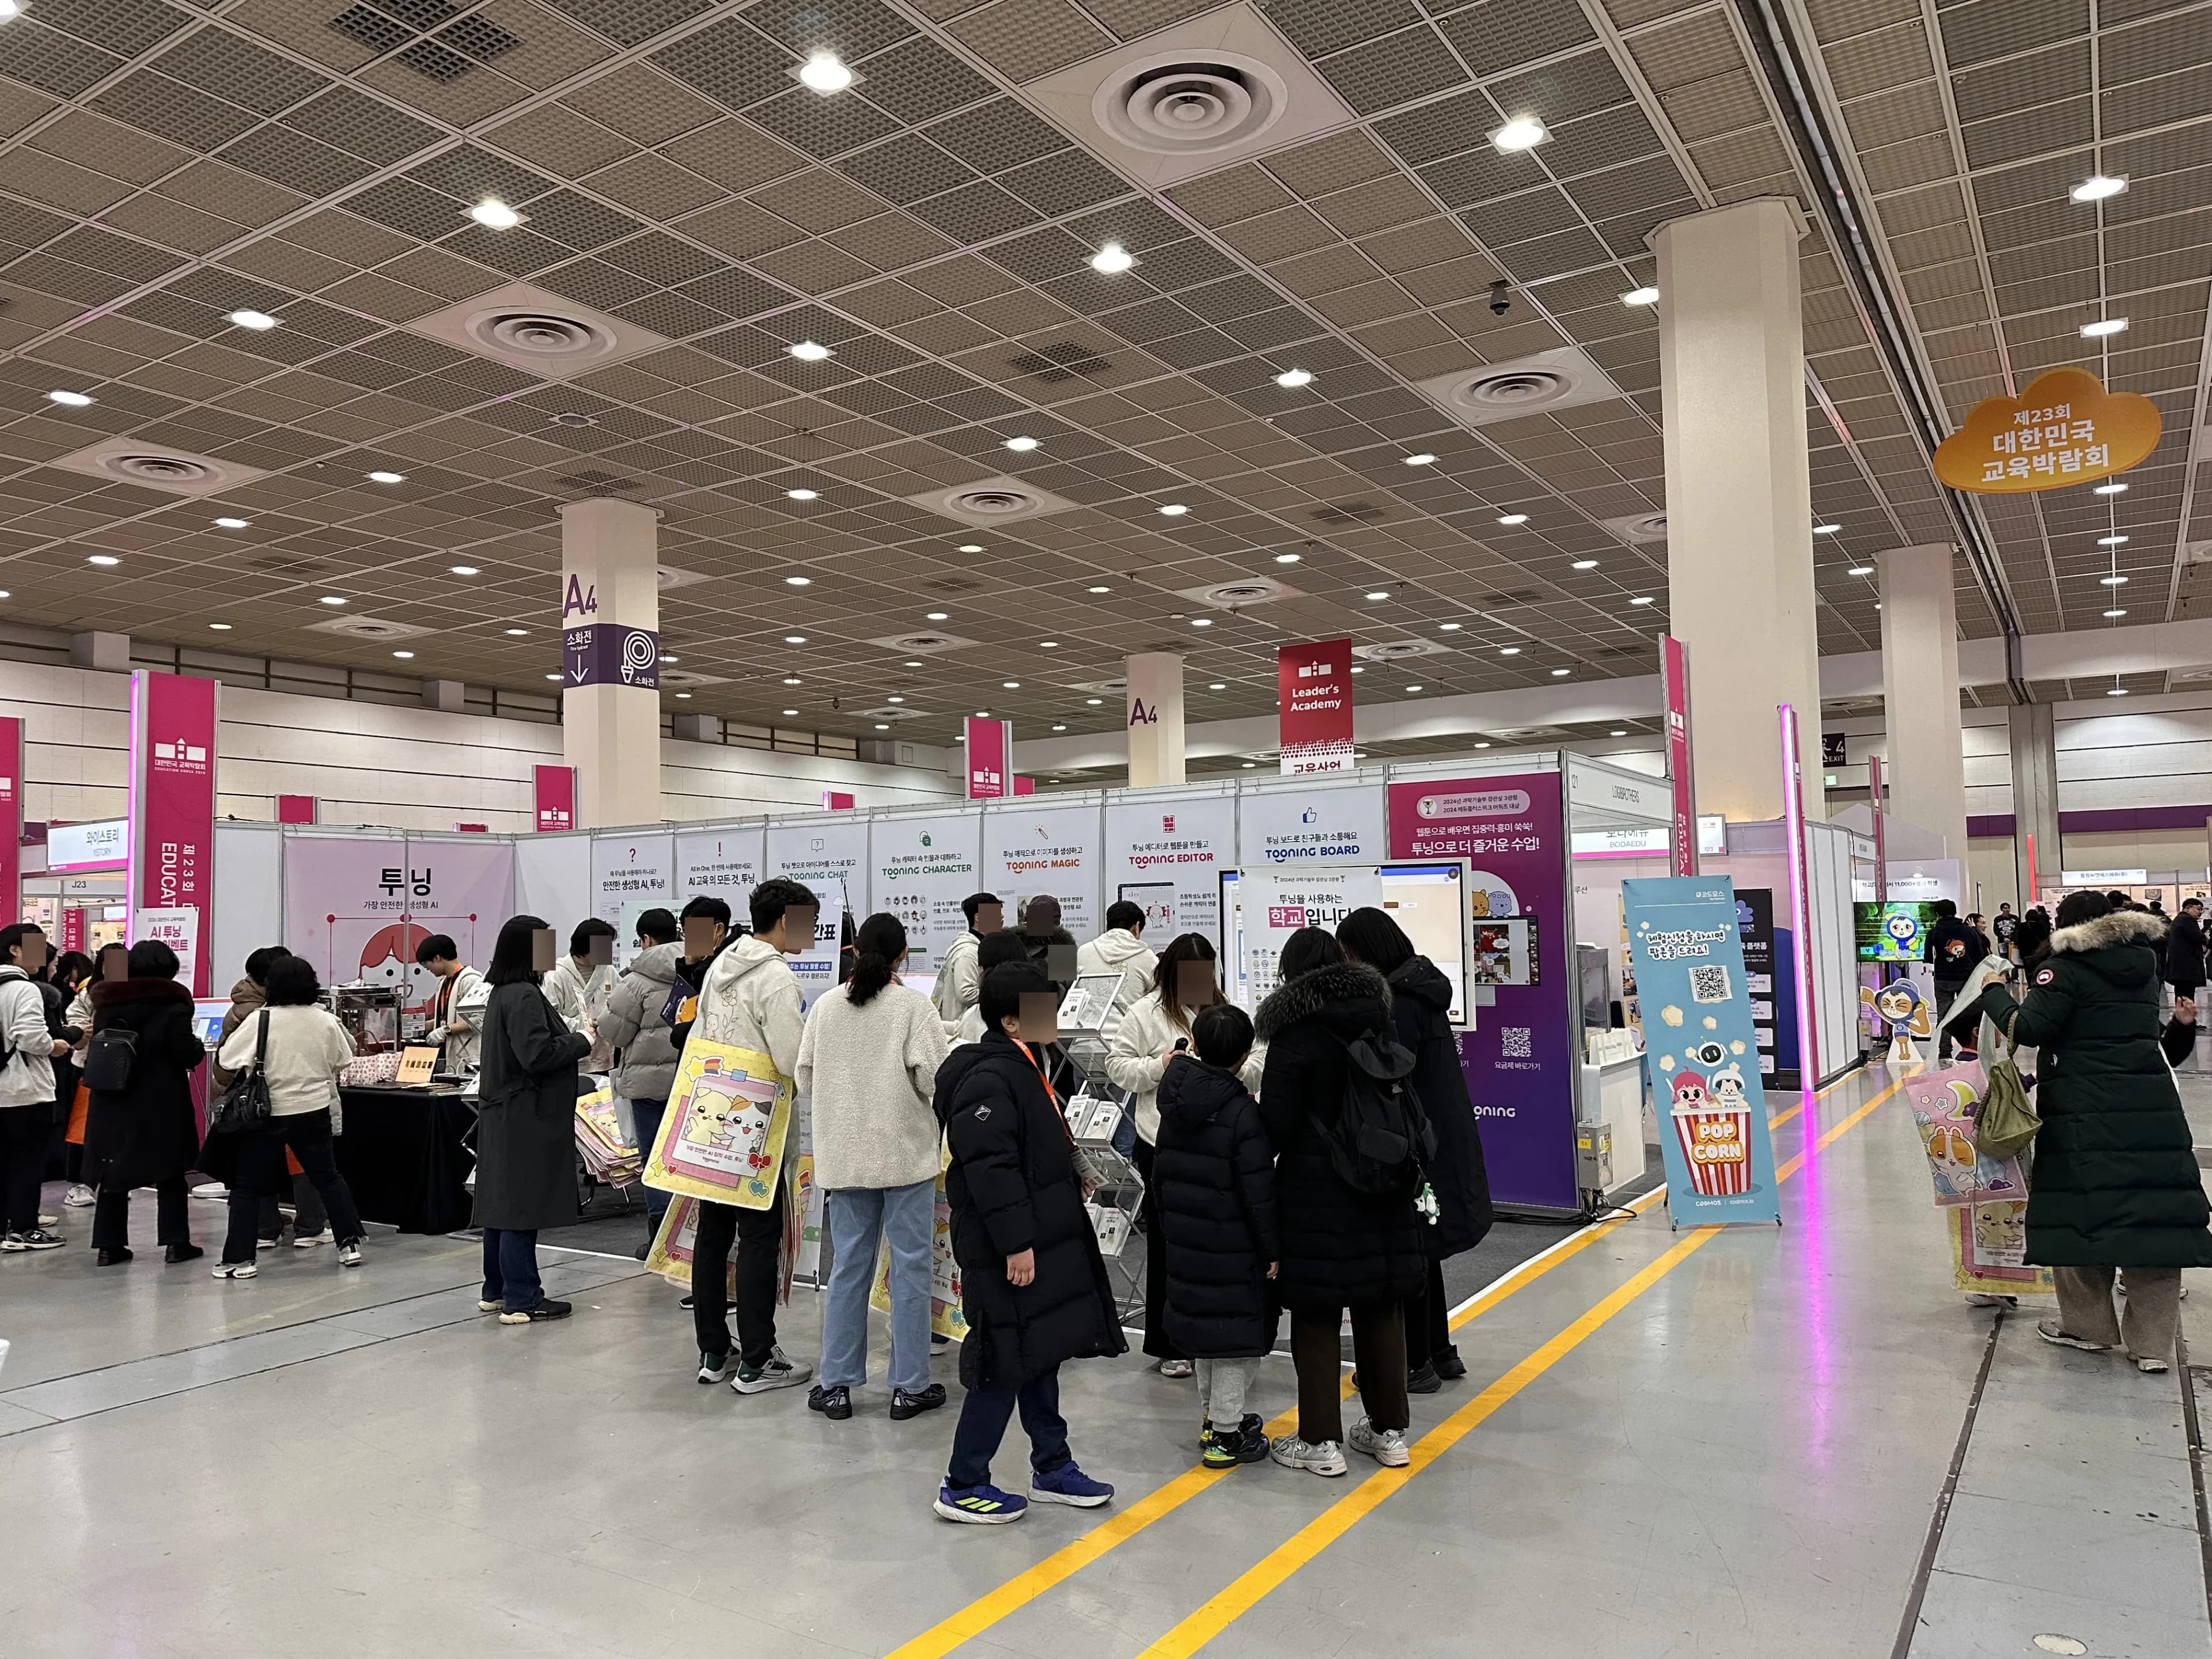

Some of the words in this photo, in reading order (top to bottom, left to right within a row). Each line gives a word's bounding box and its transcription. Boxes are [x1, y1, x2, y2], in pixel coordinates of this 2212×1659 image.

[2014, 404, 2070, 425] 제23회
[1993, 420, 2095, 454] 대한민국
[1982, 444, 2109, 482] 교육박람회
[563, 574, 597, 618] A4
[567, 630, 592, 646] 소화전
[635, 676, 654, 687] 소화전
[1293, 684, 1339, 698] Leader's
[1130, 698, 1157, 726] A4
[1290, 699, 1342, 711] Academy
[1836, 741, 1844, 753] 4
[86, 827, 119, 845] 와이스토리
[1416, 827, 1446, 837] 웹툰으로
[1447, 825, 1471, 835] 배우면
[1514, 822, 1533, 831] 쑥쑥!
[1145, 842, 1169, 851] 에디터로
[1171, 841, 1188, 850] 웹툰을
[1190, 840, 1209, 849] 만들고
[1266, 836, 1279, 845] 투닝
[1281, 835, 1300, 843] 보드로
[1301, 834, 1328, 843] 친구들과
[1330, 832, 1358, 841] 소통해요
[1411, 841, 1457, 855] 투닝으로
[1459, 840, 1471, 854] 더
[1472, 838, 1509, 853] 즐거운
[1511, 836, 1540, 851] 수업!
[1060, 847, 1083, 855] 생성하고
[1266, 847, 1316, 863] TOONING
[1320, 845, 1360, 856] BOARD
[1006, 861, 1047, 874] TOONING
[1051, 859, 1080, 868] MAGIC
[1129, 855, 1174, 869] TOONING
[1177, 853, 1213, 862] EDITOR
[789, 872, 824, 881] TOONING
[882, 867, 919, 879] TOONING
[923, 864, 972, 873] CHARACTER
[378, 868, 431, 896] 투닝
[603, 881, 620, 891] 안전한
[622, 880, 639, 890] 생성형
[650, 878, 665, 889] 투닝!
[688, 877, 695, 885] AI
[717, 874, 730, 885] 모든
[741, 873, 755, 884] 투닝
[364, 902, 378, 910] 가장
[380, 902, 403, 910] 안전한
[1279, 894, 1305, 904] 투닝을
[1308, 894, 1343, 904] 사용하는
[150, 926, 161, 938] AI
[163, 926, 181, 938] 투닝
[1648, 931, 1693, 944] 체험신청을
[1695, 932, 1724, 941] 하시면
[1650, 946, 1676, 958] 팝콘을
[1679, 945, 1707, 955] 드려요!
[1747, 942, 1767, 950] 플랫폼
[1514, 1062, 1541, 1070] 바로가기
[1699, 1124, 1734, 1139] POP
[1695, 1144, 1741, 1160] CORN
